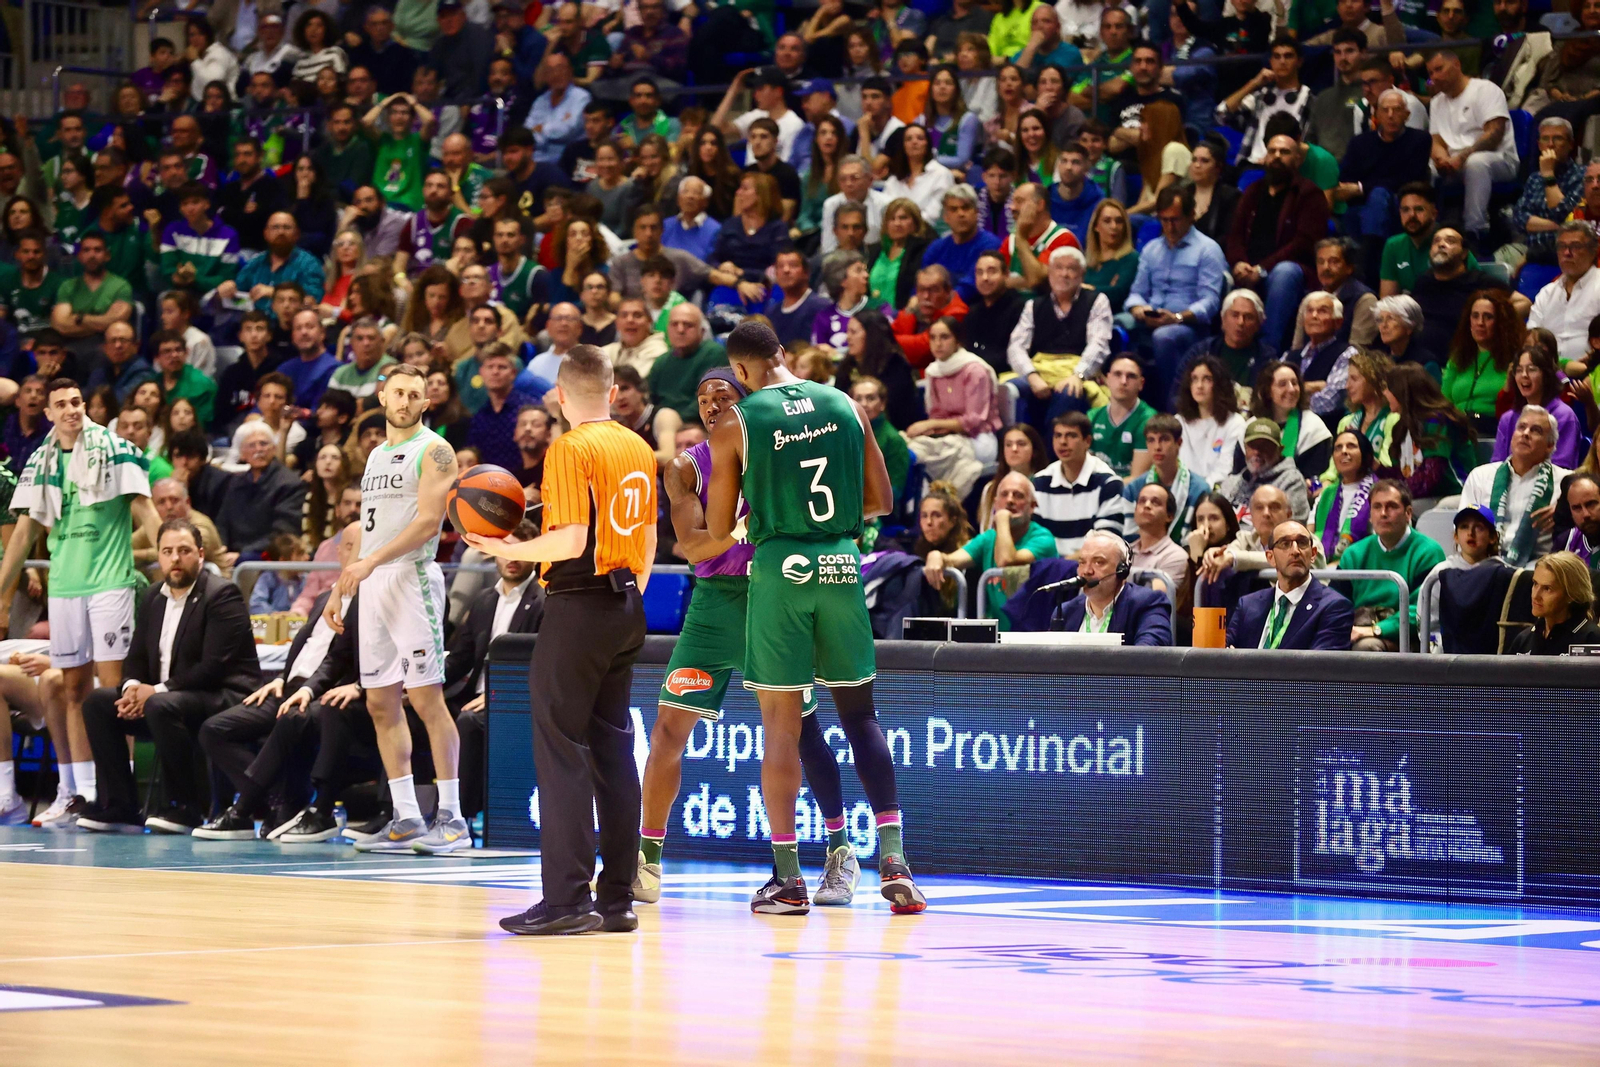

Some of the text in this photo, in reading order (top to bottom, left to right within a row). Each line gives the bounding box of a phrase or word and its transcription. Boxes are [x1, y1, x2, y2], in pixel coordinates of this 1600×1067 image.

[782, 397, 815, 416] EJIM
[800, 456, 835, 523] 3
[624, 488, 640, 519] 71
[365, 508, 376, 532] 3
[818, 554, 857, 565] COSTA
[818, 565, 858, 575] DEL SOL
[818, 573, 859, 585] MÁLAGA
[926, 716, 1145, 775] Provincial
[682, 782, 737, 839] de
